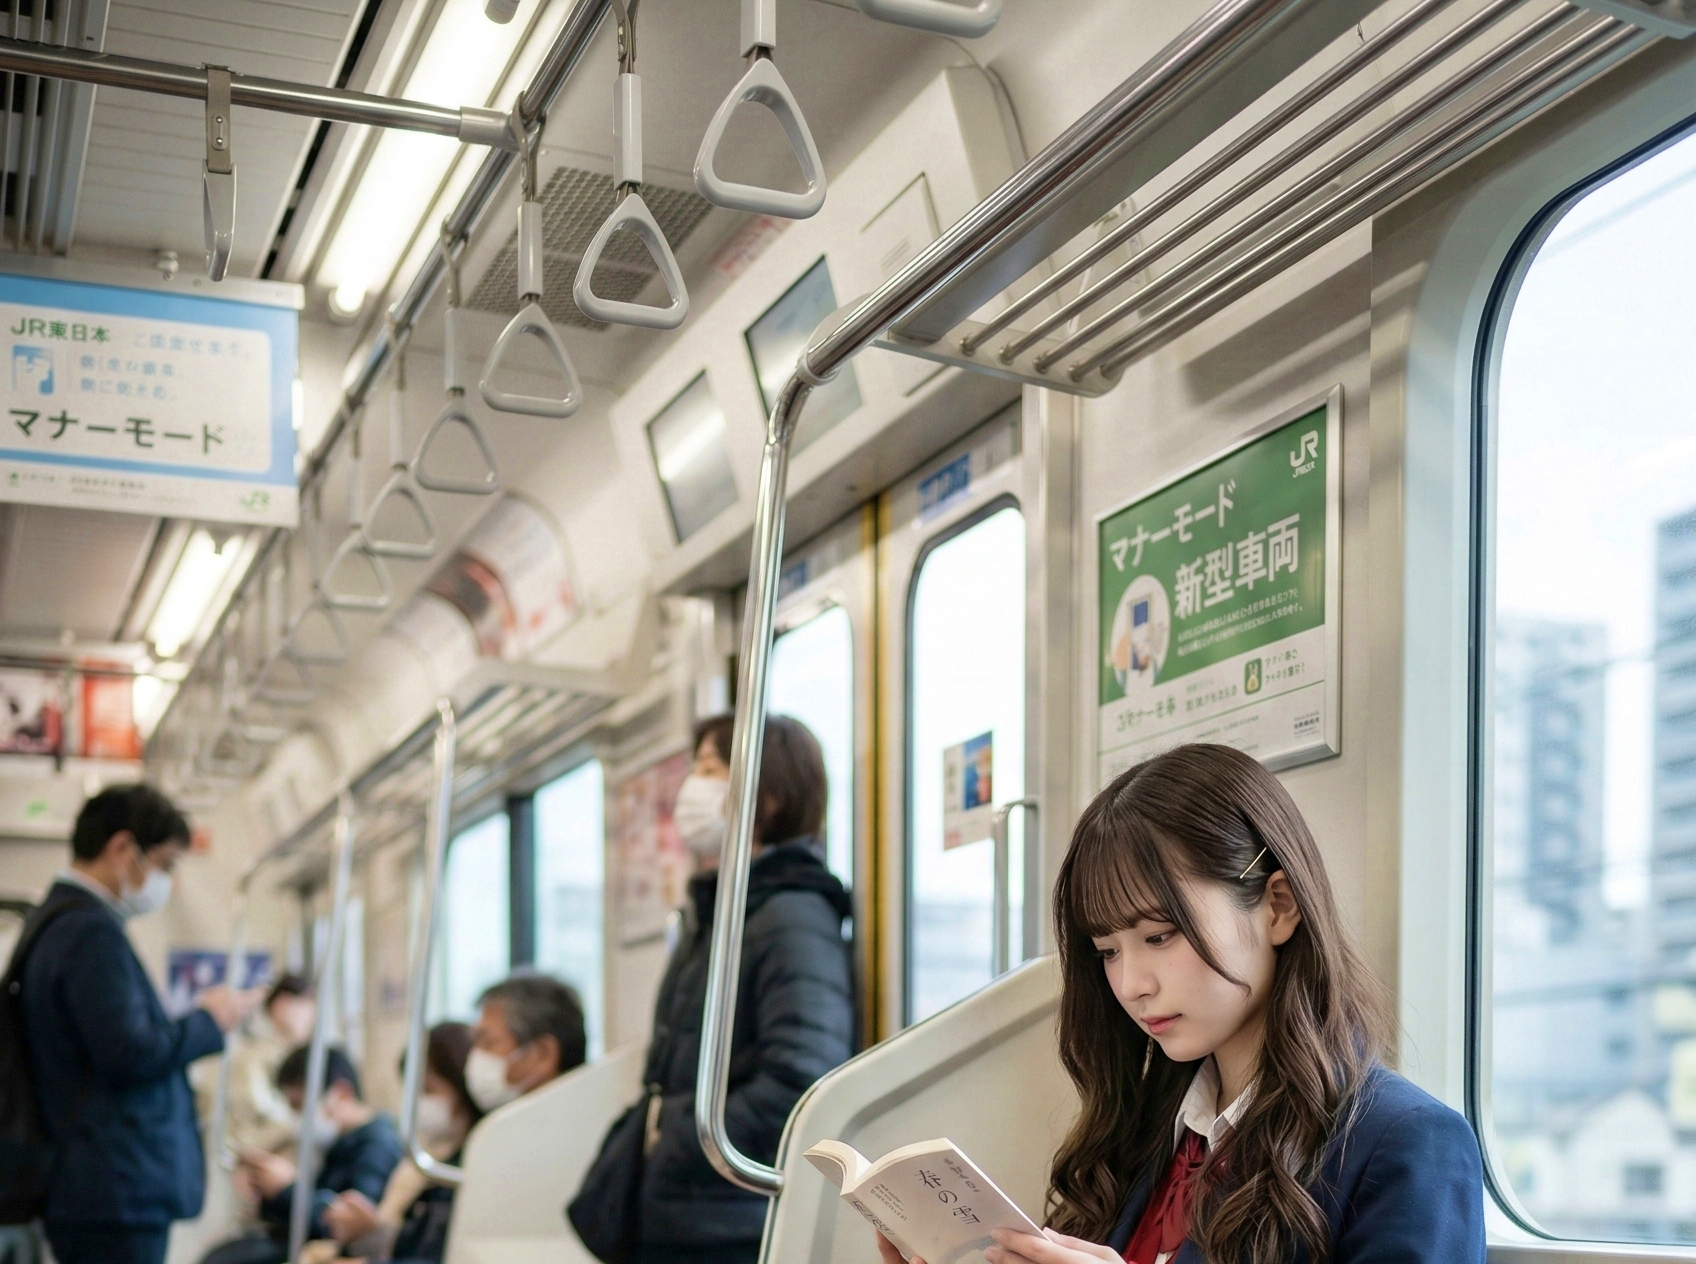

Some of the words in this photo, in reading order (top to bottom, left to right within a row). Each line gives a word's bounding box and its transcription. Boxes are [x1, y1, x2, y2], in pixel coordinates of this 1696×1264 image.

[10, 317, 111, 343] JR東日本
[9, 407, 224, 454] マナーモード
[1290, 429, 1319, 468] JR
[1109, 478, 1237, 574] マナーモード
[1174, 512, 1300, 620] 新型車両
